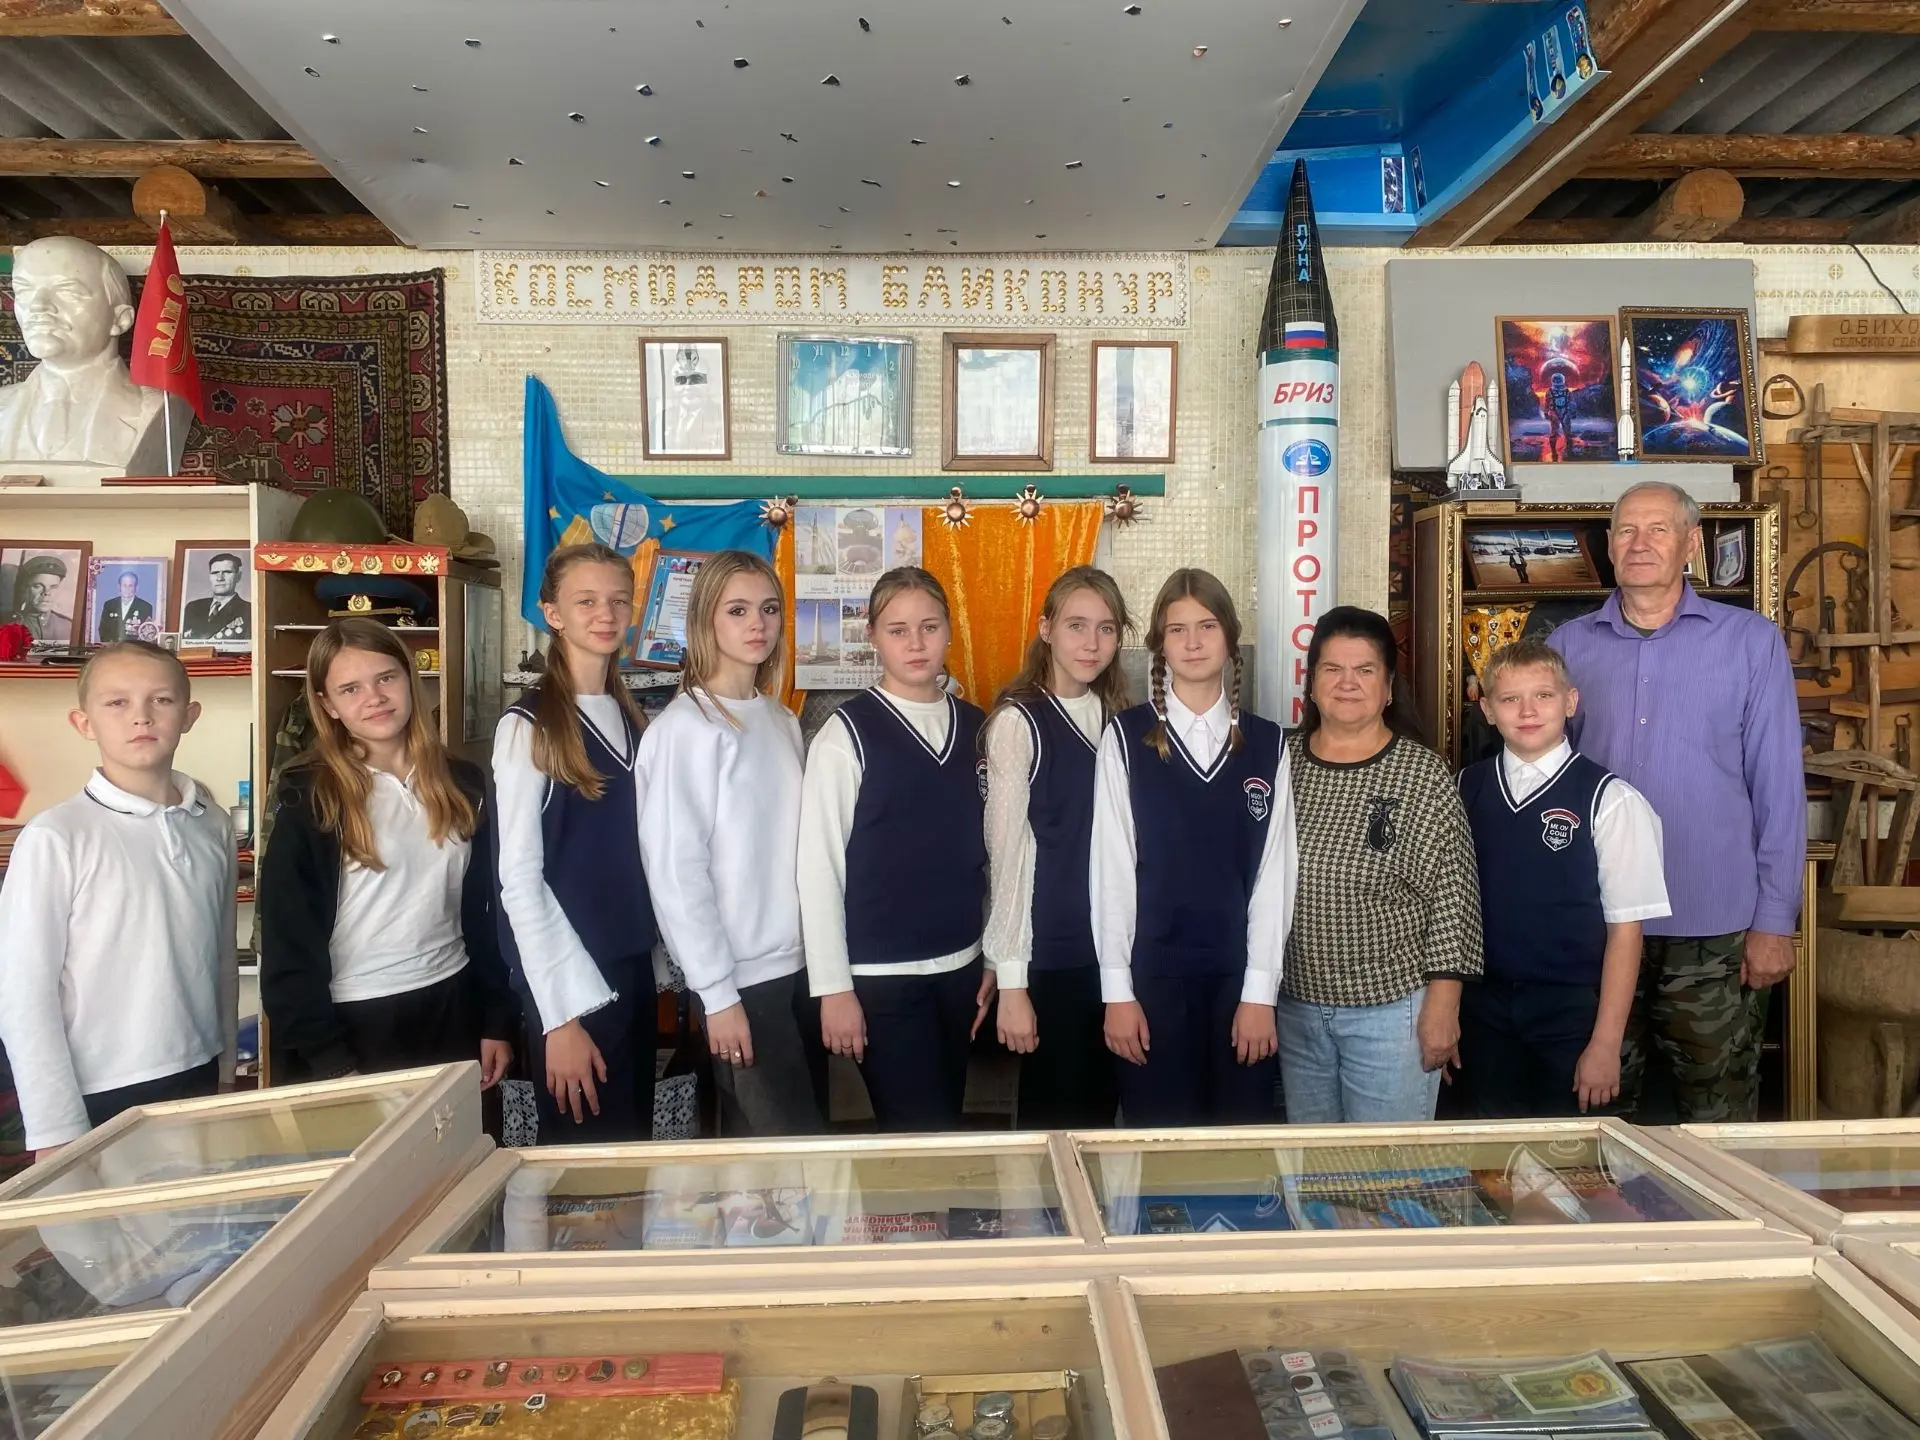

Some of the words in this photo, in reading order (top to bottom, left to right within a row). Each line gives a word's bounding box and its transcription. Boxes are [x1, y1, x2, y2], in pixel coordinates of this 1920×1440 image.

[1295, 224, 1311, 282] ЛУНА
[493, 262, 847, 310] КОСМОДРОМ
[1272, 381, 1336, 405] БРИЗ
[1550, 829, 1567, 838] СОШ
